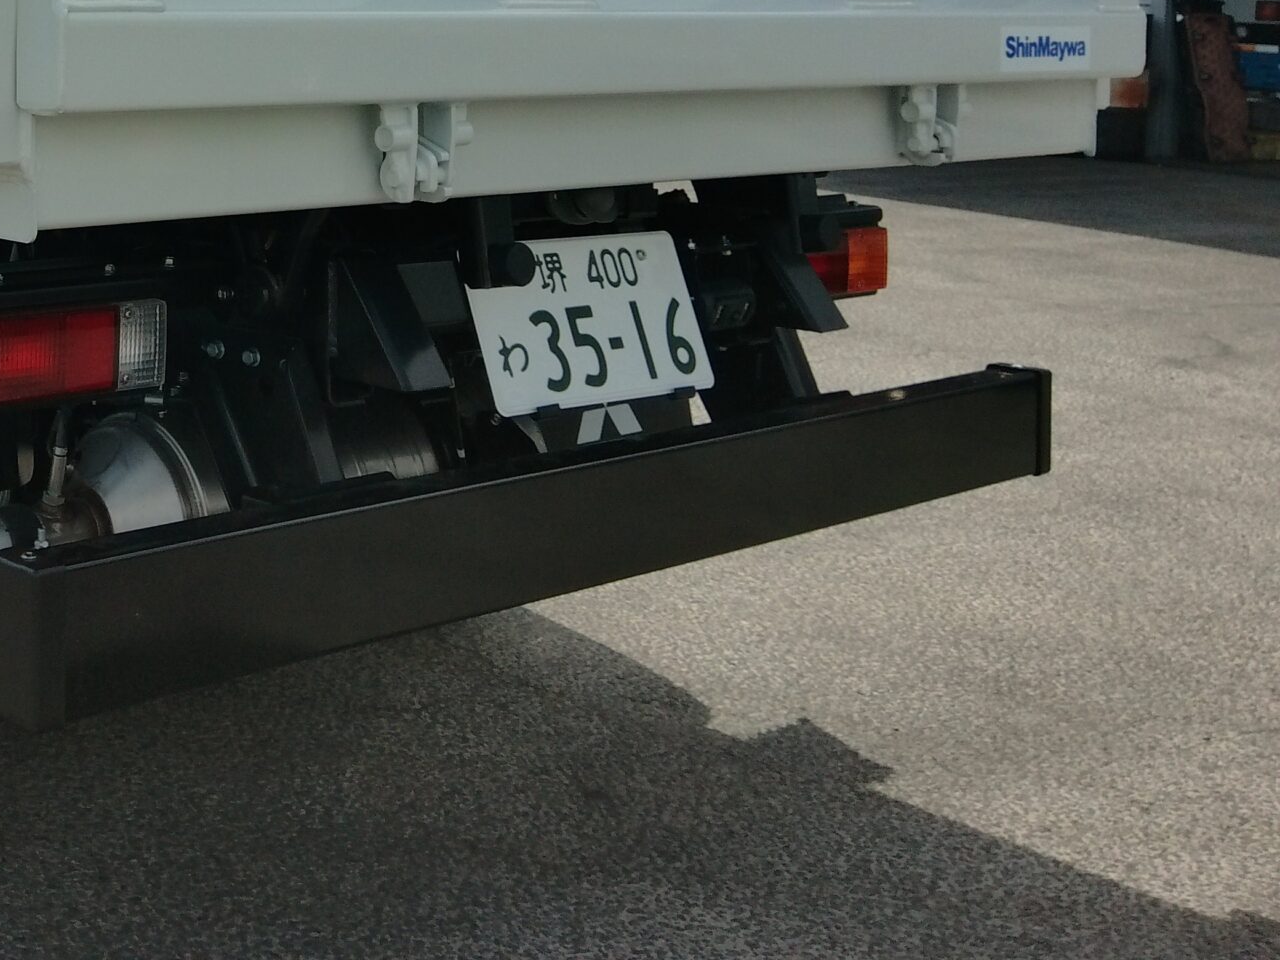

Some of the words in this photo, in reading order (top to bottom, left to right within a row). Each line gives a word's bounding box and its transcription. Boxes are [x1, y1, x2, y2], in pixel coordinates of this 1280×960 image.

[1005, 36, 1086, 61] ShinMaywa
[587, 247, 639, 289] 400
[498, 334, 530, 378] わ
[528, 297, 697, 392] 35-16
